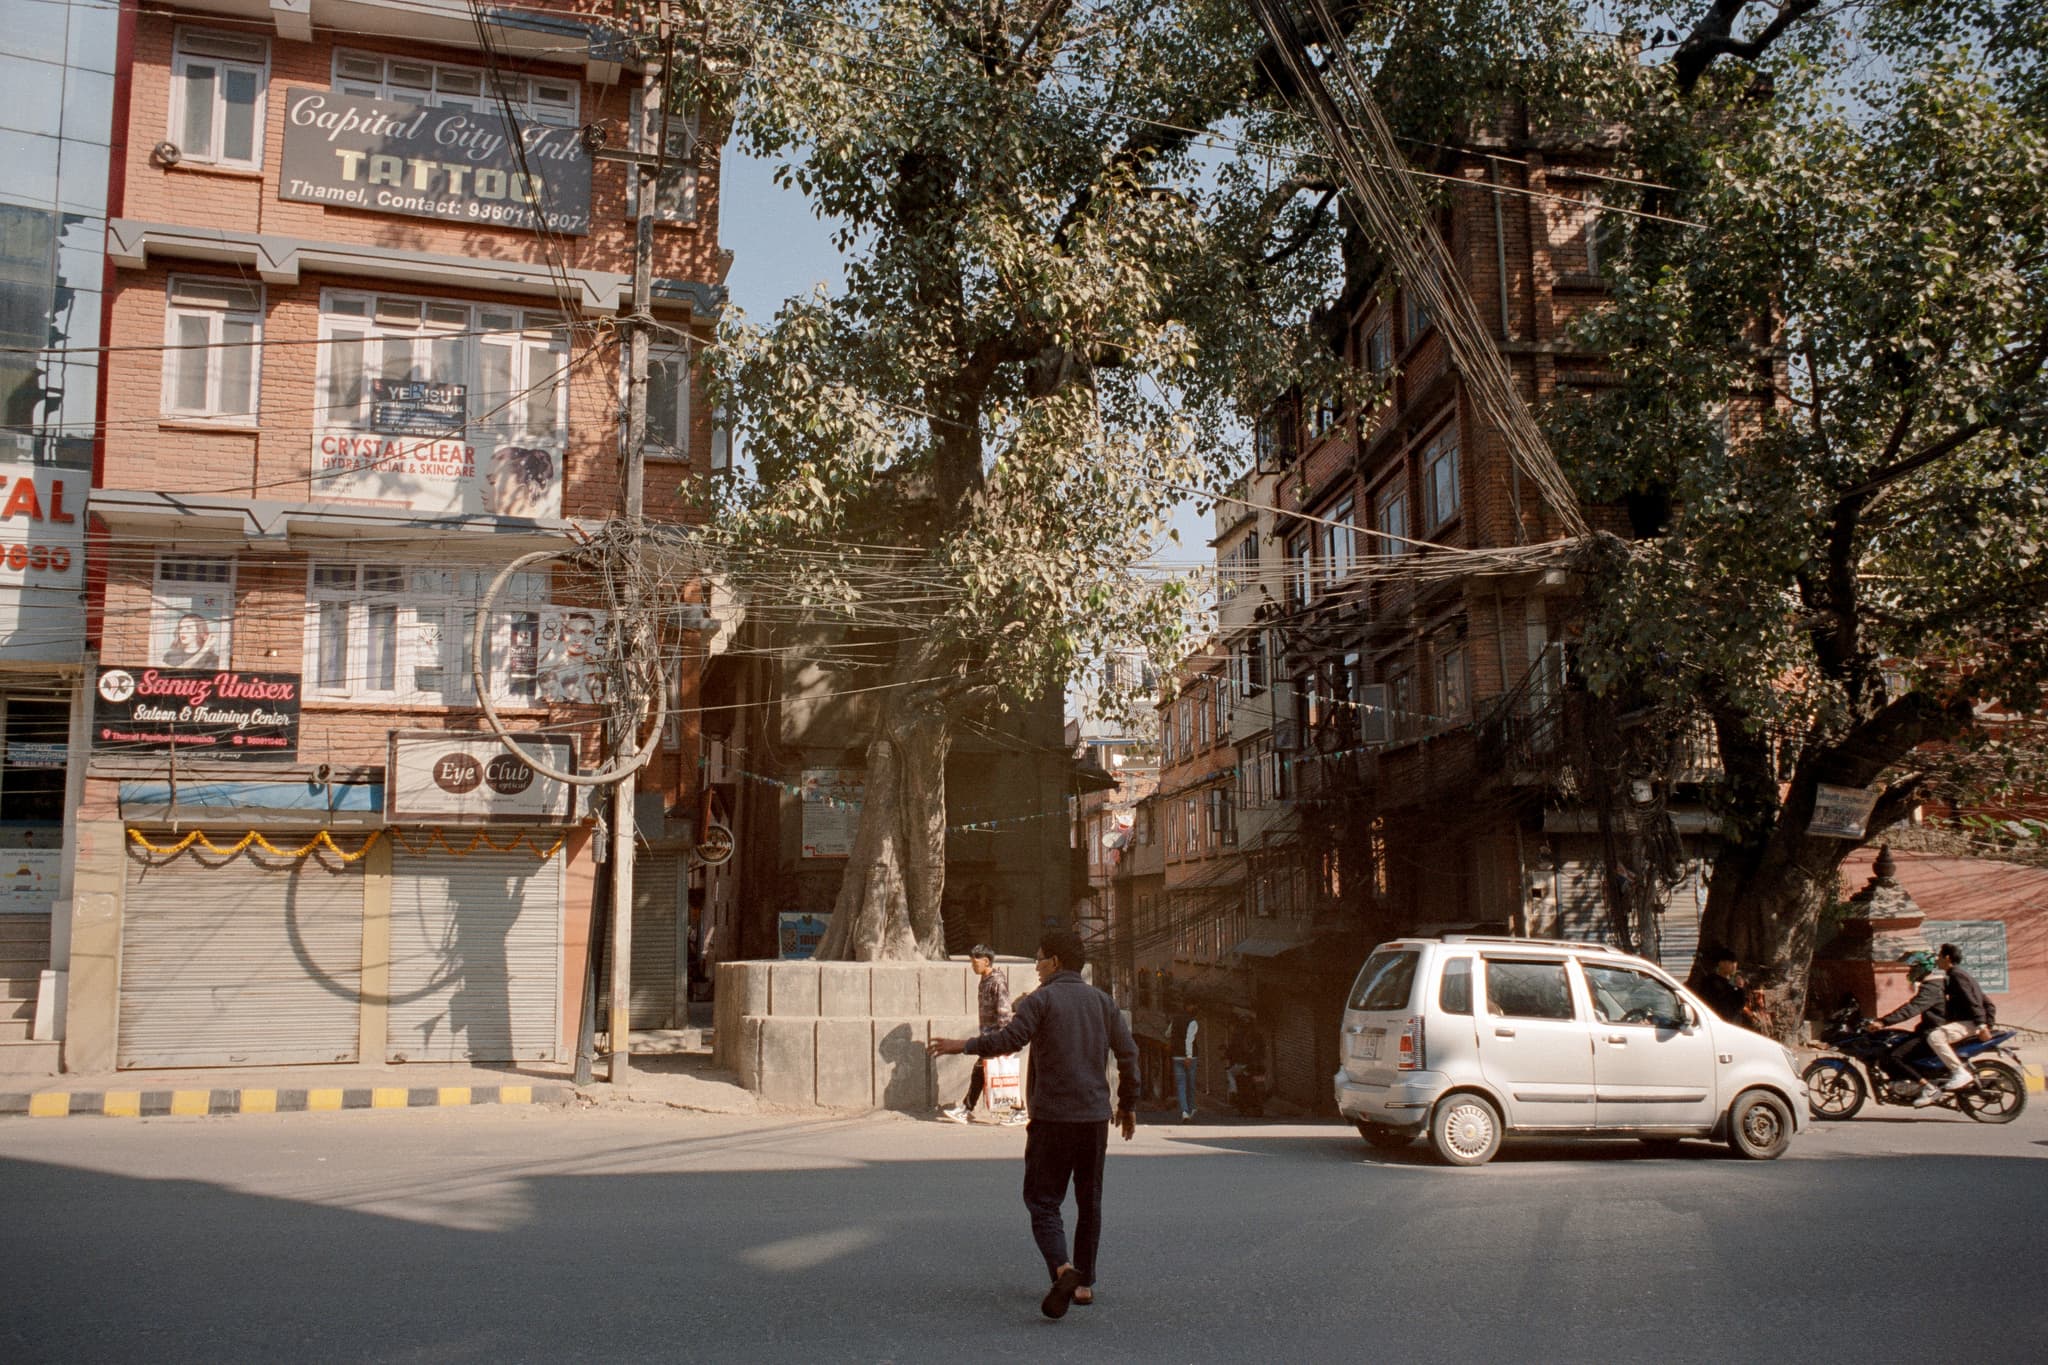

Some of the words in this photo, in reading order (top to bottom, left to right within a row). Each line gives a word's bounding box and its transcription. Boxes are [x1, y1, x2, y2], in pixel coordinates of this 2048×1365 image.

[291, 95, 428, 142] Capital
[434, 115, 503, 161] City
[519, 125, 584, 162] Ink
[335, 148, 543, 204] TATTOO
[290, 180, 369, 206] Thamel,
[377, 191, 462, 216] Contact:
[321, 437, 406, 459] CRYSTAL
[412, 443, 476, 466] CLEAR
[322, 457, 360, 470] HYDRA
[365, 459, 405, 474] FACIAL
[408, 464, 416, 474] &
[419, 462, 476, 478] SKINCARE
[213, 672, 295, 701] Unisex
[133, 703, 177, 722] Saloon
[179, 706, 193, 722] &
[194, 706, 249, 730] Training
[250, 708, 290, 726] Center
[440, 761, 475, 785] Eye
[486, 761, 529, 781] Club
